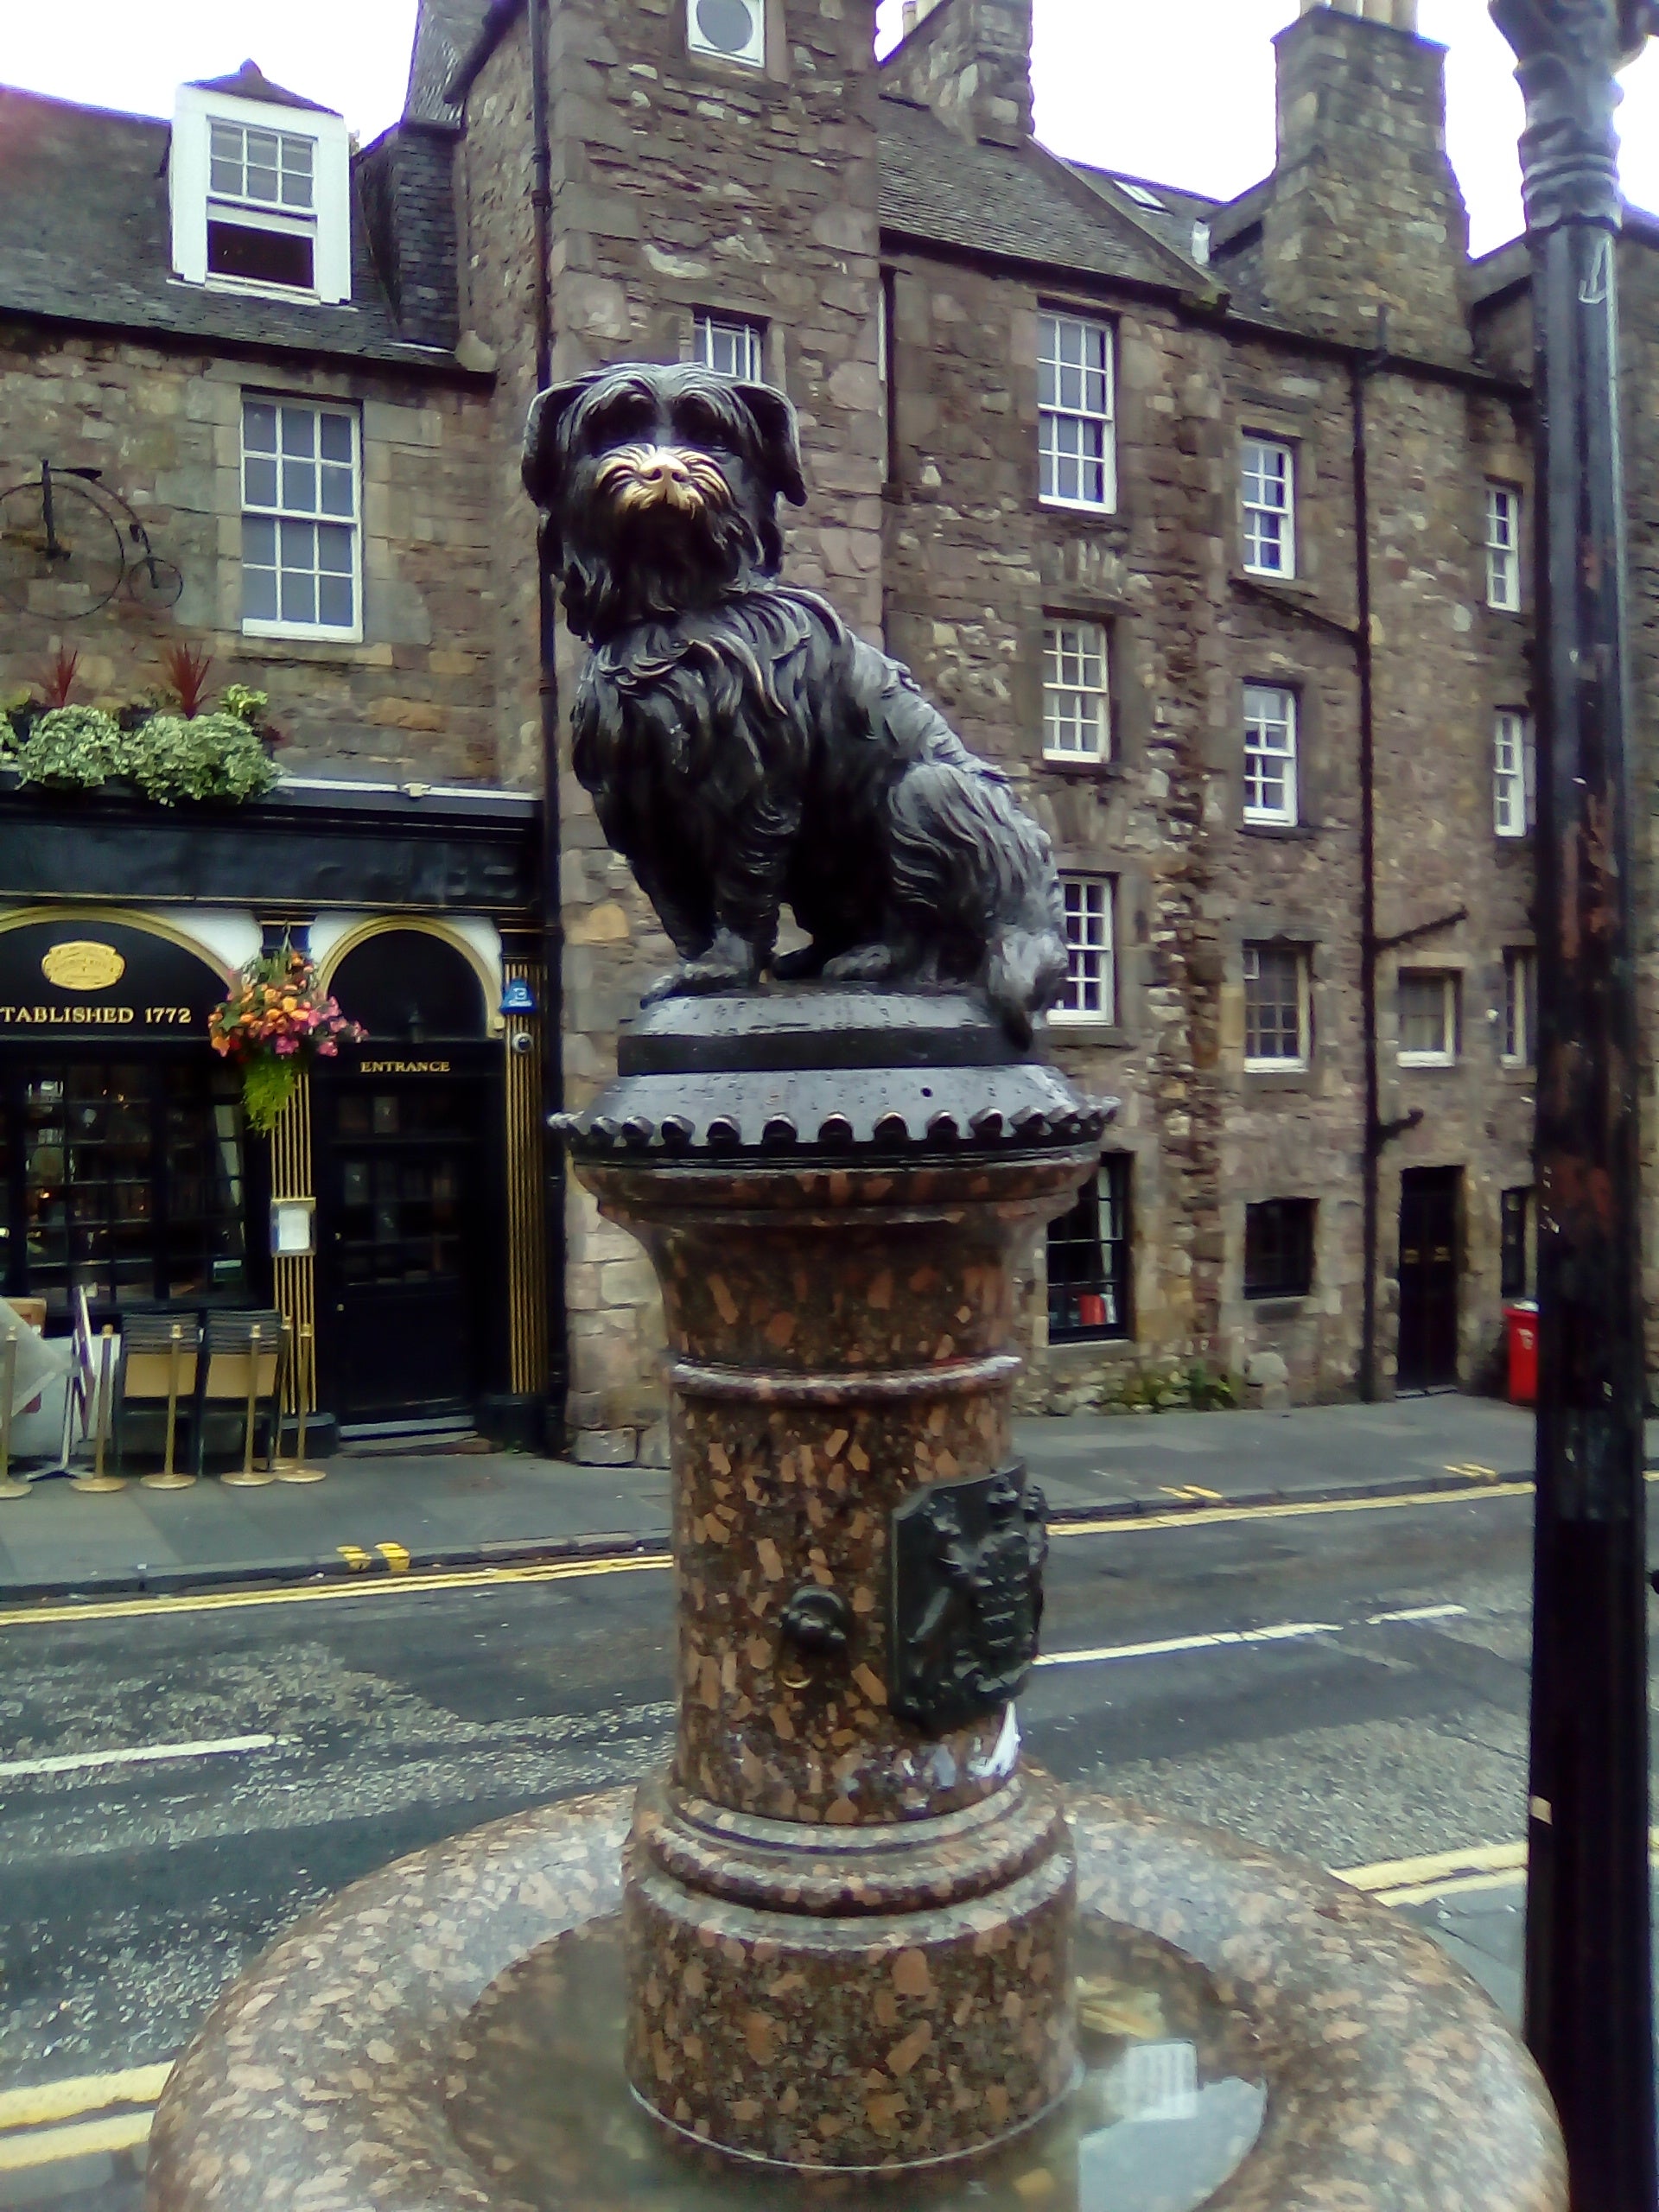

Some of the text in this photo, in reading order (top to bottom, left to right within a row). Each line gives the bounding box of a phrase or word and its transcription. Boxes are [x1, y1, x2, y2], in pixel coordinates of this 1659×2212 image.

[0, 1006, 192, 1024] TABLISHED 1772
[360, 1061, 450, 1072] ENTRANCE
